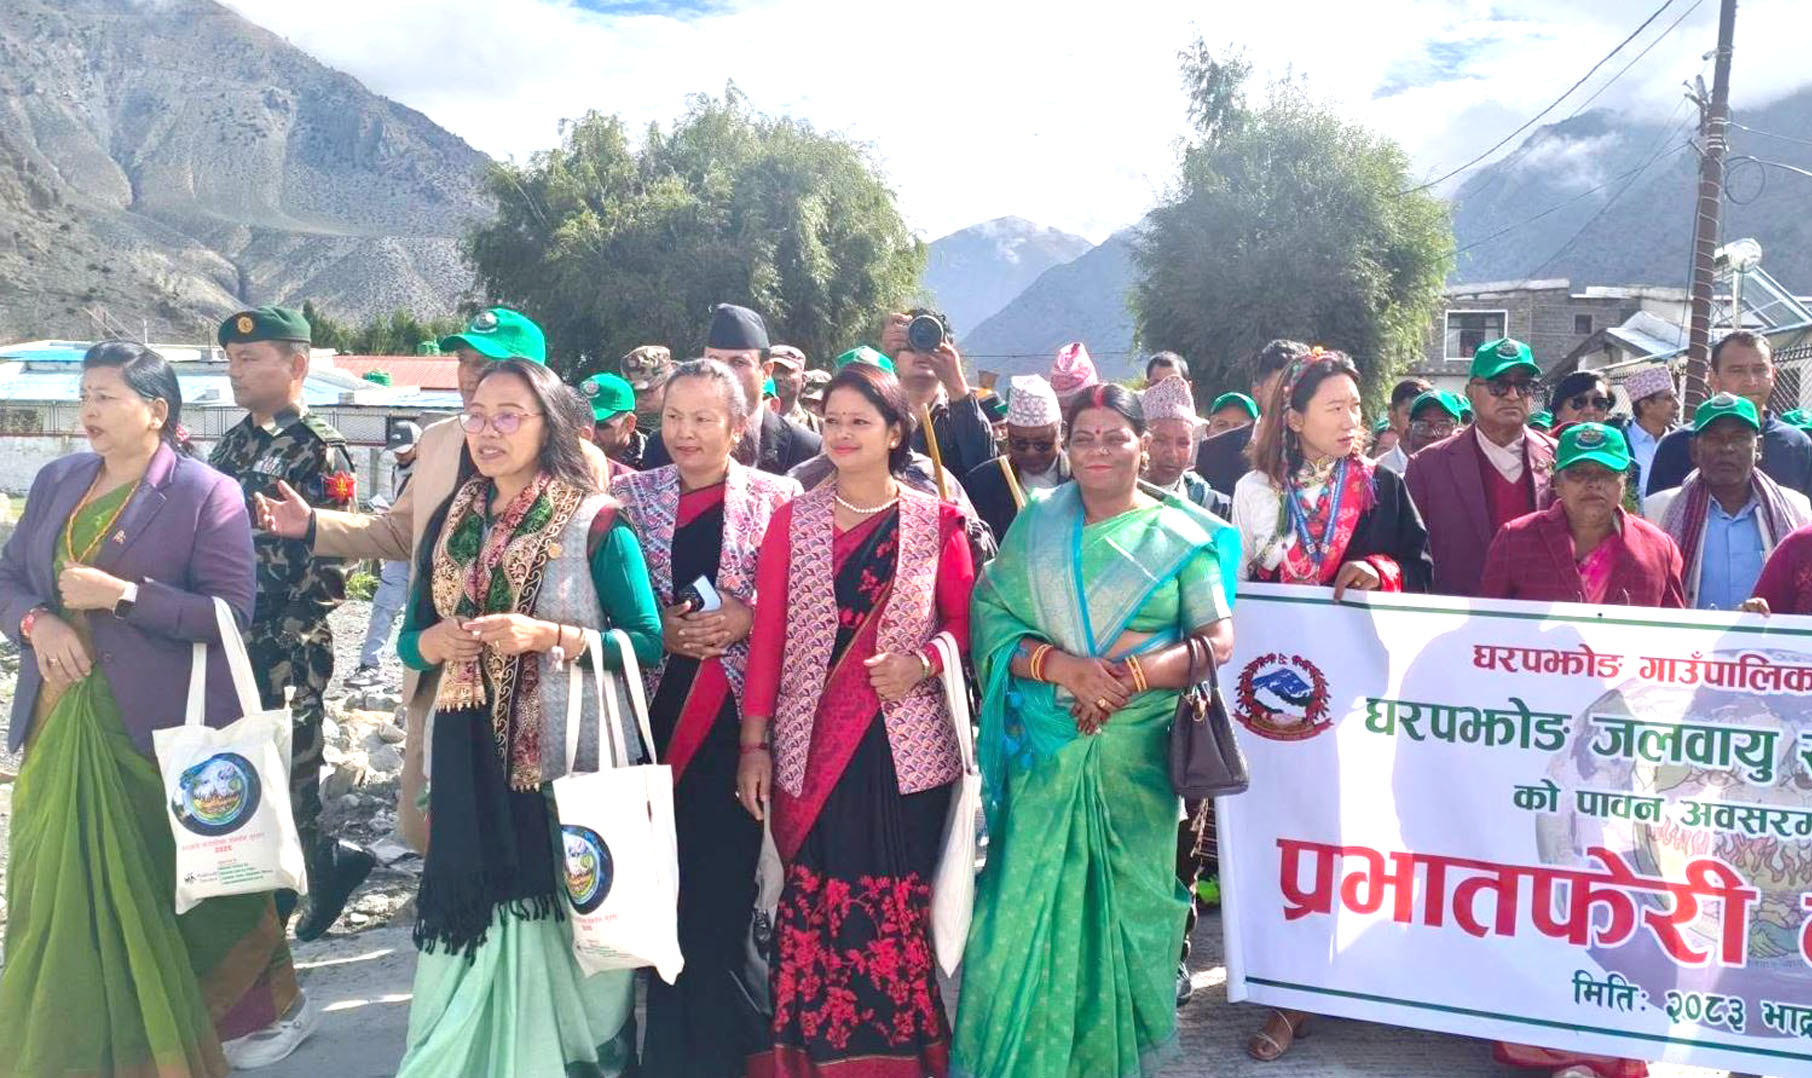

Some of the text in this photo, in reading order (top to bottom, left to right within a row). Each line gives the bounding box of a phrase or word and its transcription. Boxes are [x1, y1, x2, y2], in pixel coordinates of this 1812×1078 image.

[1473, 644, 1624, 678] घरपझोङ
[1365, 697, 1572, 751] घरपझोङ
[1592, 715, 1779, 783] जलवायु
[1513, 779, 1561, 812] को
[1577, 789, 1664, 823] पावन
[1276, 838, 1757, 965] प्रभातफेरी
[1665, 992, 1745, 1031] २०८३
